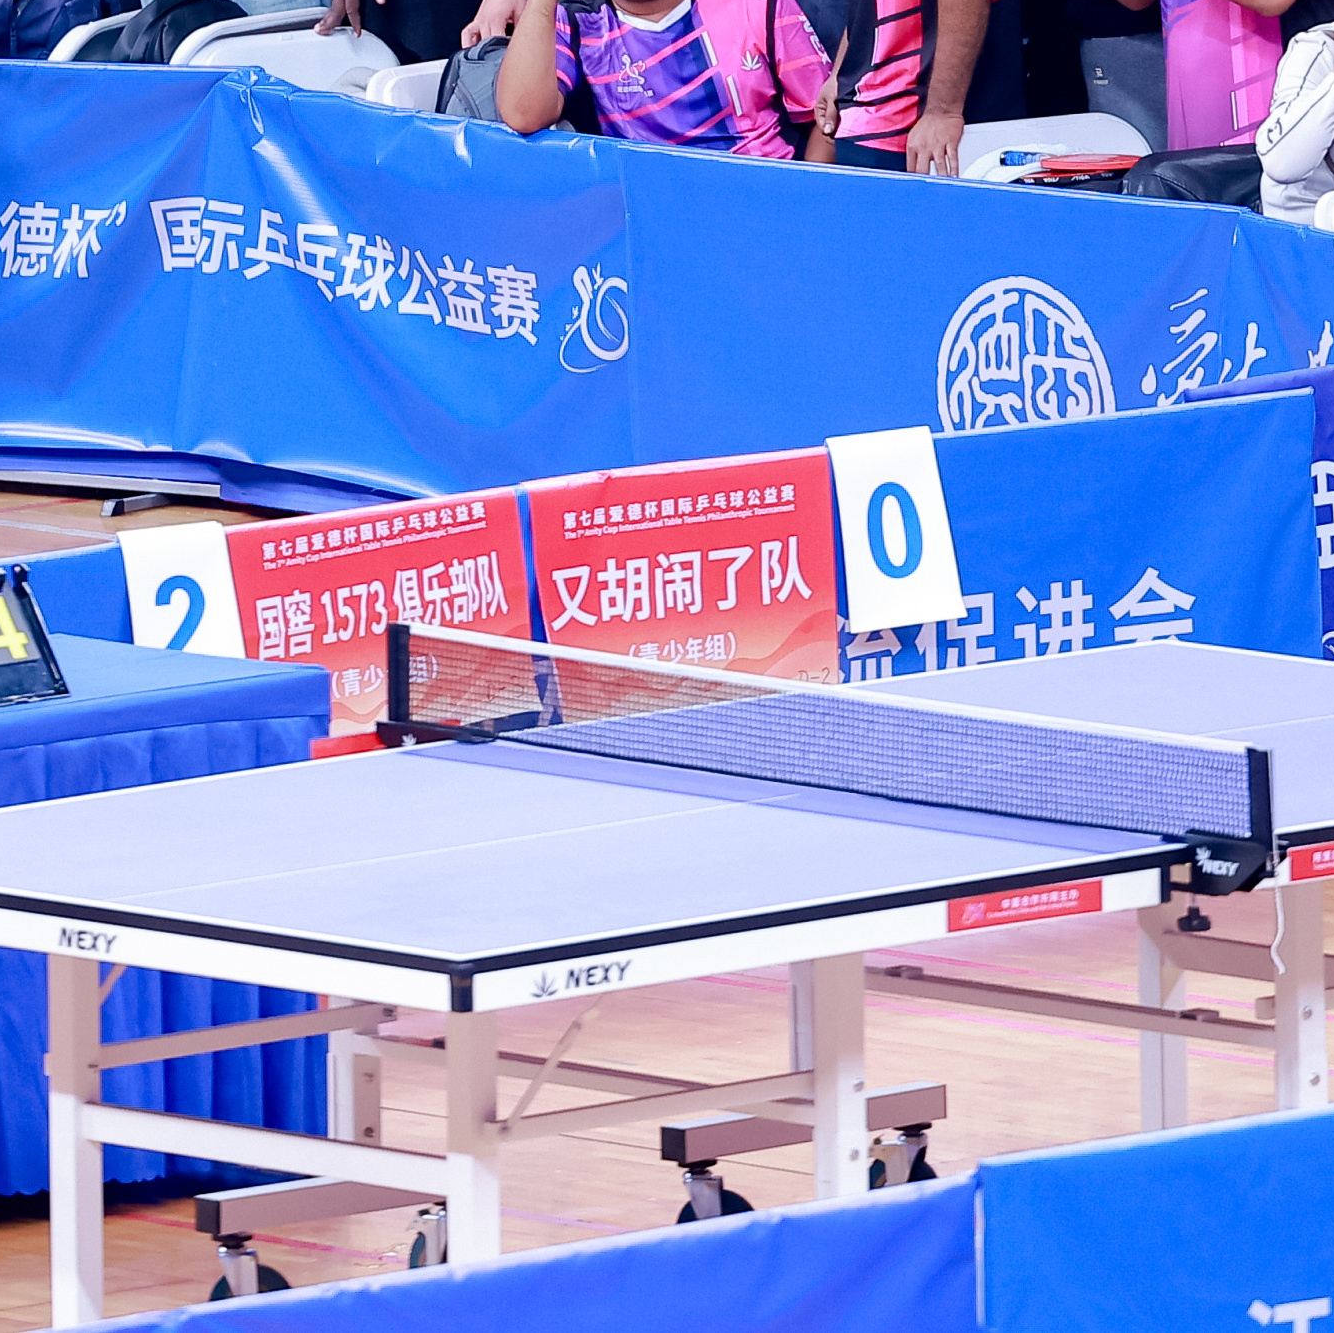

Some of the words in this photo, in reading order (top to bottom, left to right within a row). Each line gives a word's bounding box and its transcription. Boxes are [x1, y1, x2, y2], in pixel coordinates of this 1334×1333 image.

[150, 195, 542, 346] 国际乒乓球公益赛
[262, 501, 487, 561] 第七届爱德杯国际乒乓球公益赛
[563, 484, 796, 530] 第七届爱德杯国际乒乓球公益赛
[867, 482, 924, 579] 0
[154, 575, 208, 652] 2
[255, 589, 316, 661] 国窖
[320, 579, 389, 645] 1573
[391, 550, 509, 627] 俱乐部队
[551, 535, 813, 633] 又胡闹了队
[1202, 857, 1241, 876] NEXY
[59, 926, 118, 955] NEXY
[564, 959, 632, 991] NEXY
